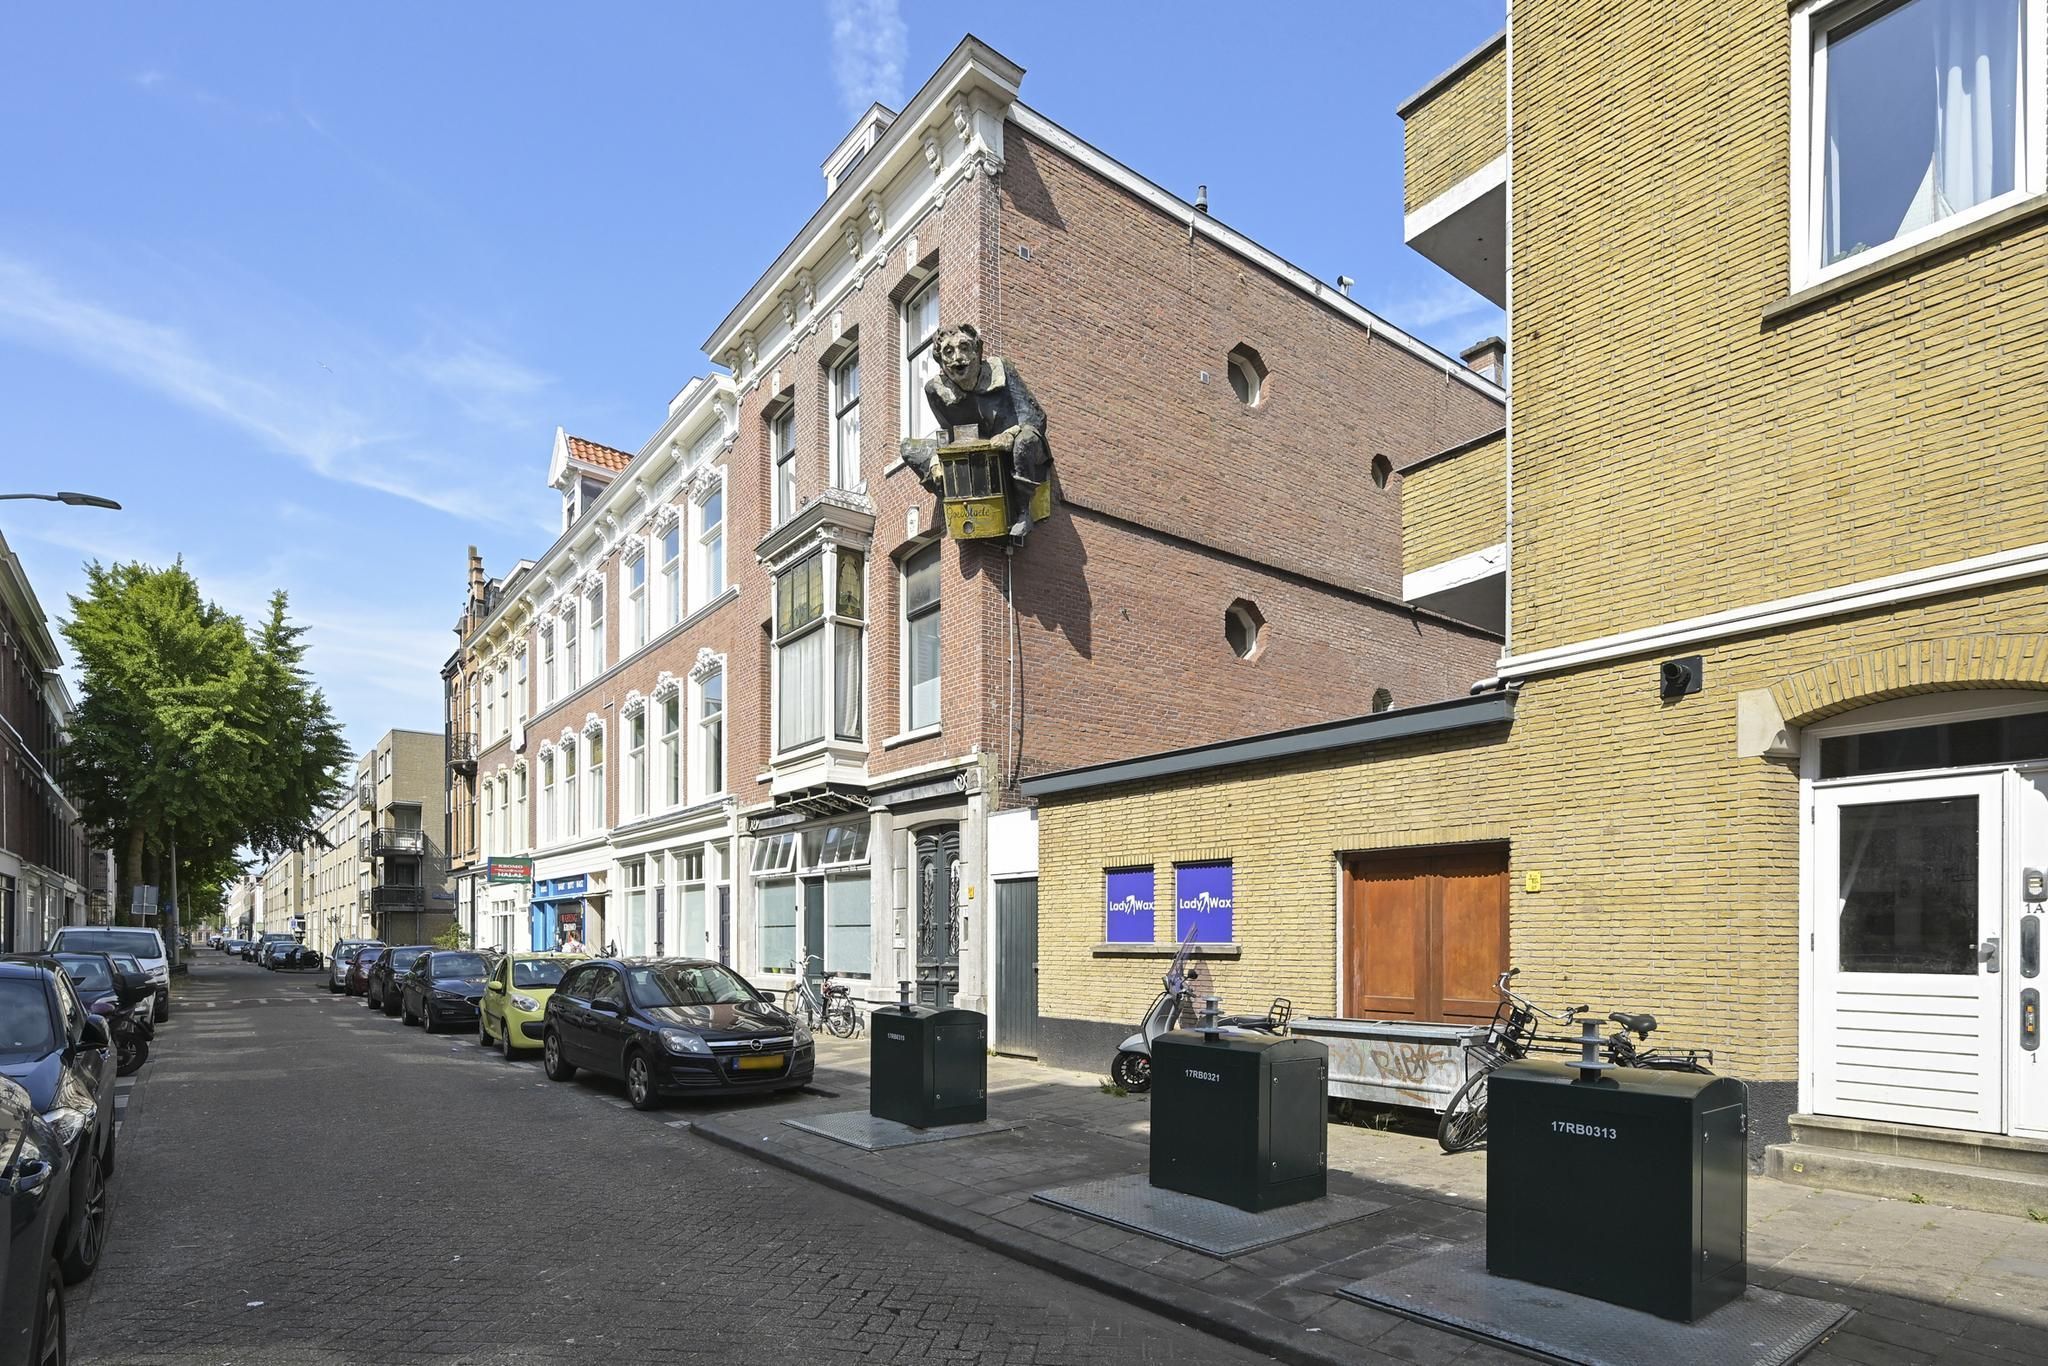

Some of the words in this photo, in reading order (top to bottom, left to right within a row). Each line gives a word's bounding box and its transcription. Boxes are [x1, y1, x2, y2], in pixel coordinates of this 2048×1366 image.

[1109, 900, 1128, 913] Lady
[1135, 899, 1154, 911] Wax
[1179, 897, 1201, 911] Lady
[1209, 897, 1231, 909] Wax
[2025, 903, 2046, 914] 1A
[2030, 1052, 2037, 1064] 1
[1185, 1069, 1220, 1082] 17RB0321
[1551, 1120, 1617, 1139] 17RB0313
